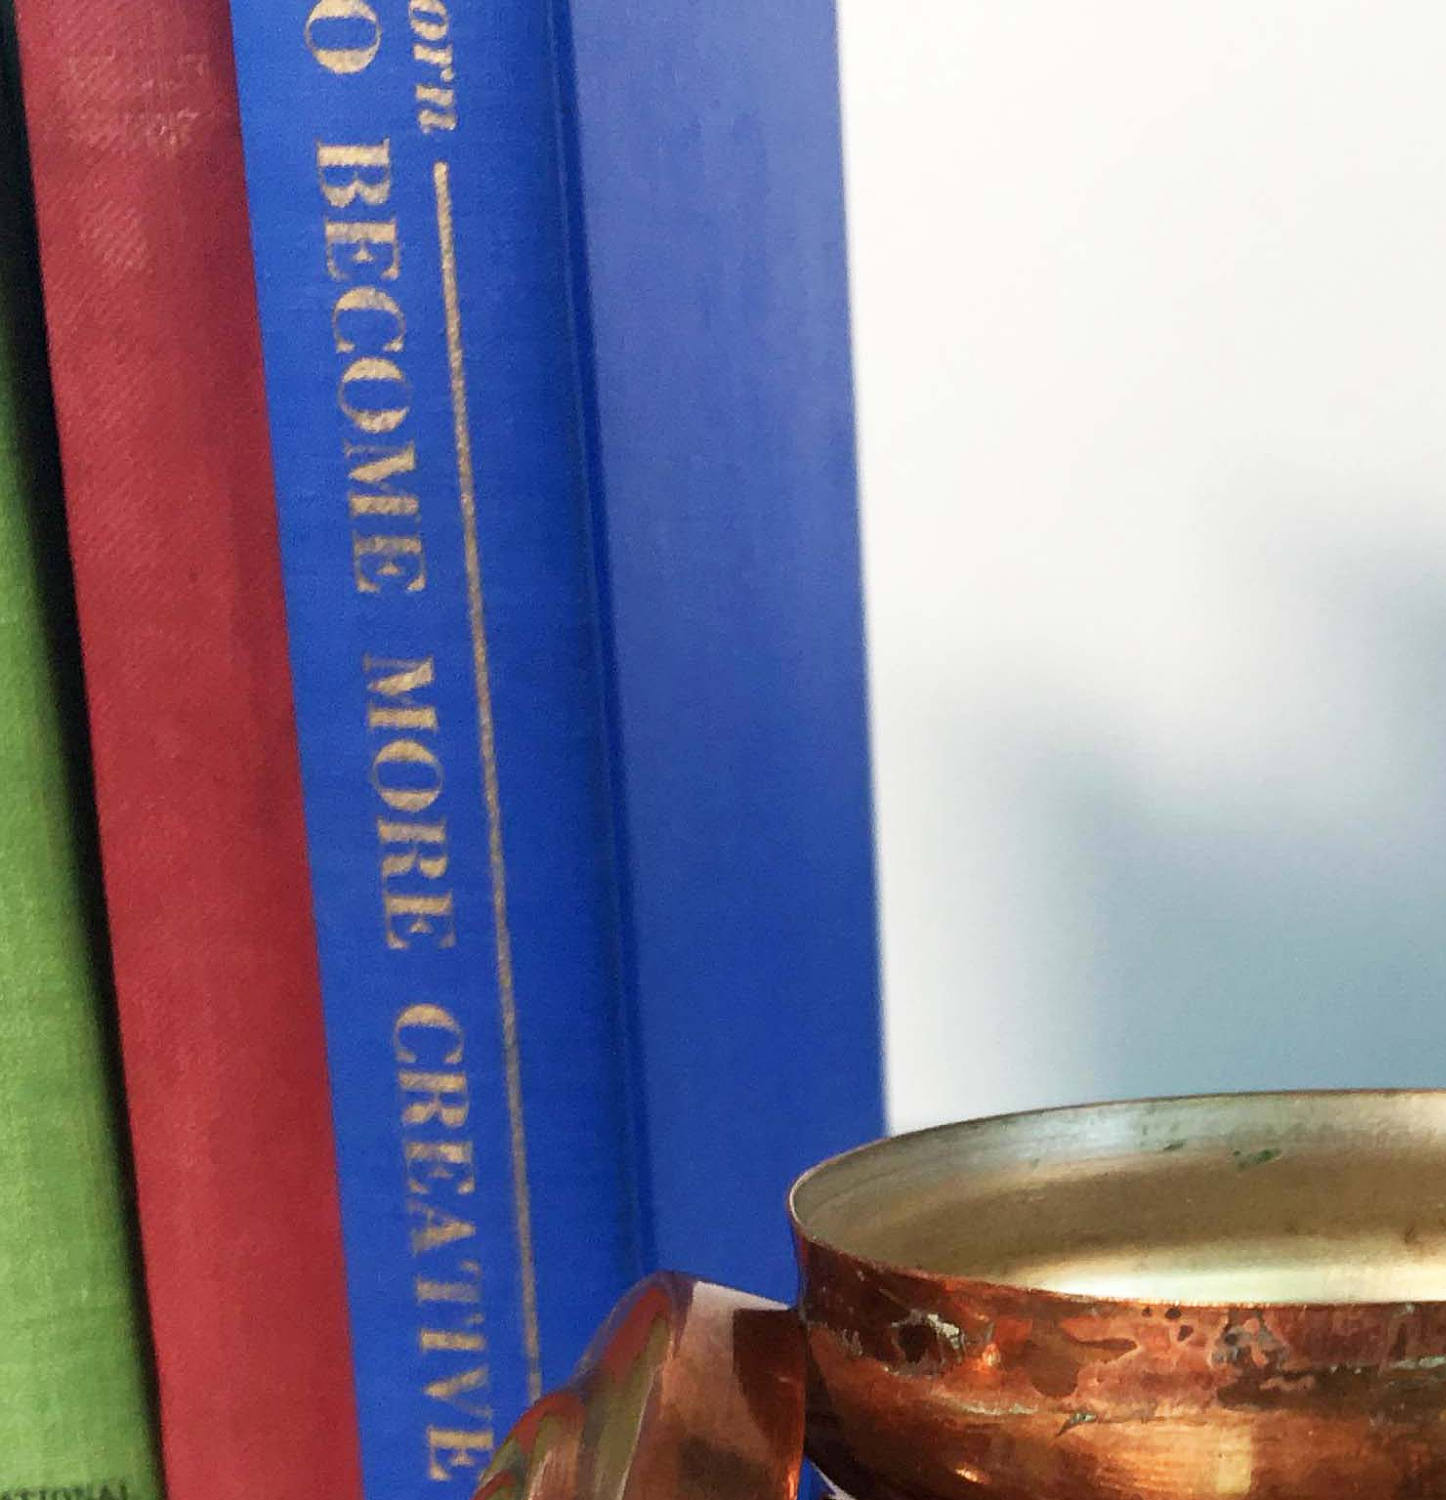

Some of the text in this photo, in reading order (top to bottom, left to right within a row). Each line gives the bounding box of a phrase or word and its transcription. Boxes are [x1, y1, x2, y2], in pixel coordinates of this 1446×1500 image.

[315, 137, 428, 594] BECOME
[361, 654, 457, 949] MORE
[391, 1003, 496, 1482] CREATIVE
